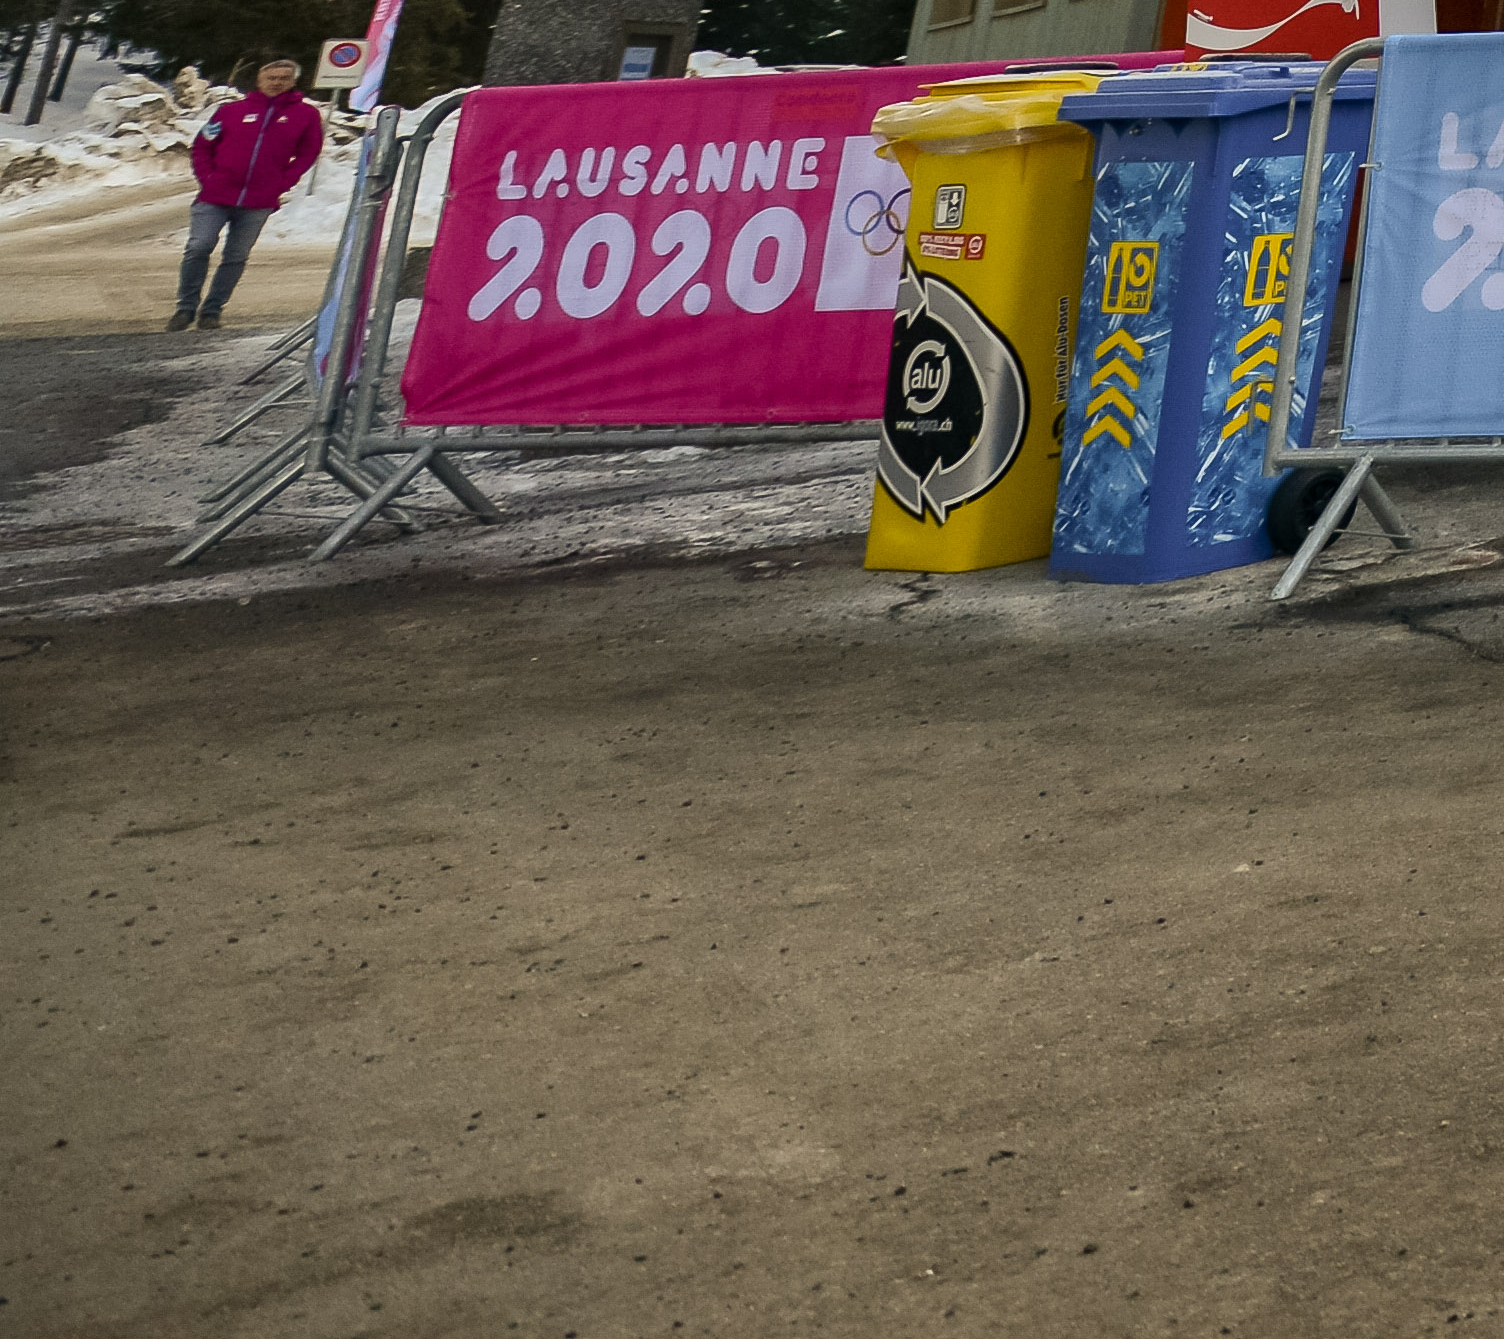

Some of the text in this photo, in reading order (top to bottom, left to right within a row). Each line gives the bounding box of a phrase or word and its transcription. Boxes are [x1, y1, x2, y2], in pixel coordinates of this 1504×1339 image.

[496, 137, 826, 200] LAUSANNE
[467, 206, 808, 322] 2020
[1124, 290, 1147, 308] PET
[911, 361, 942, 390] alu
